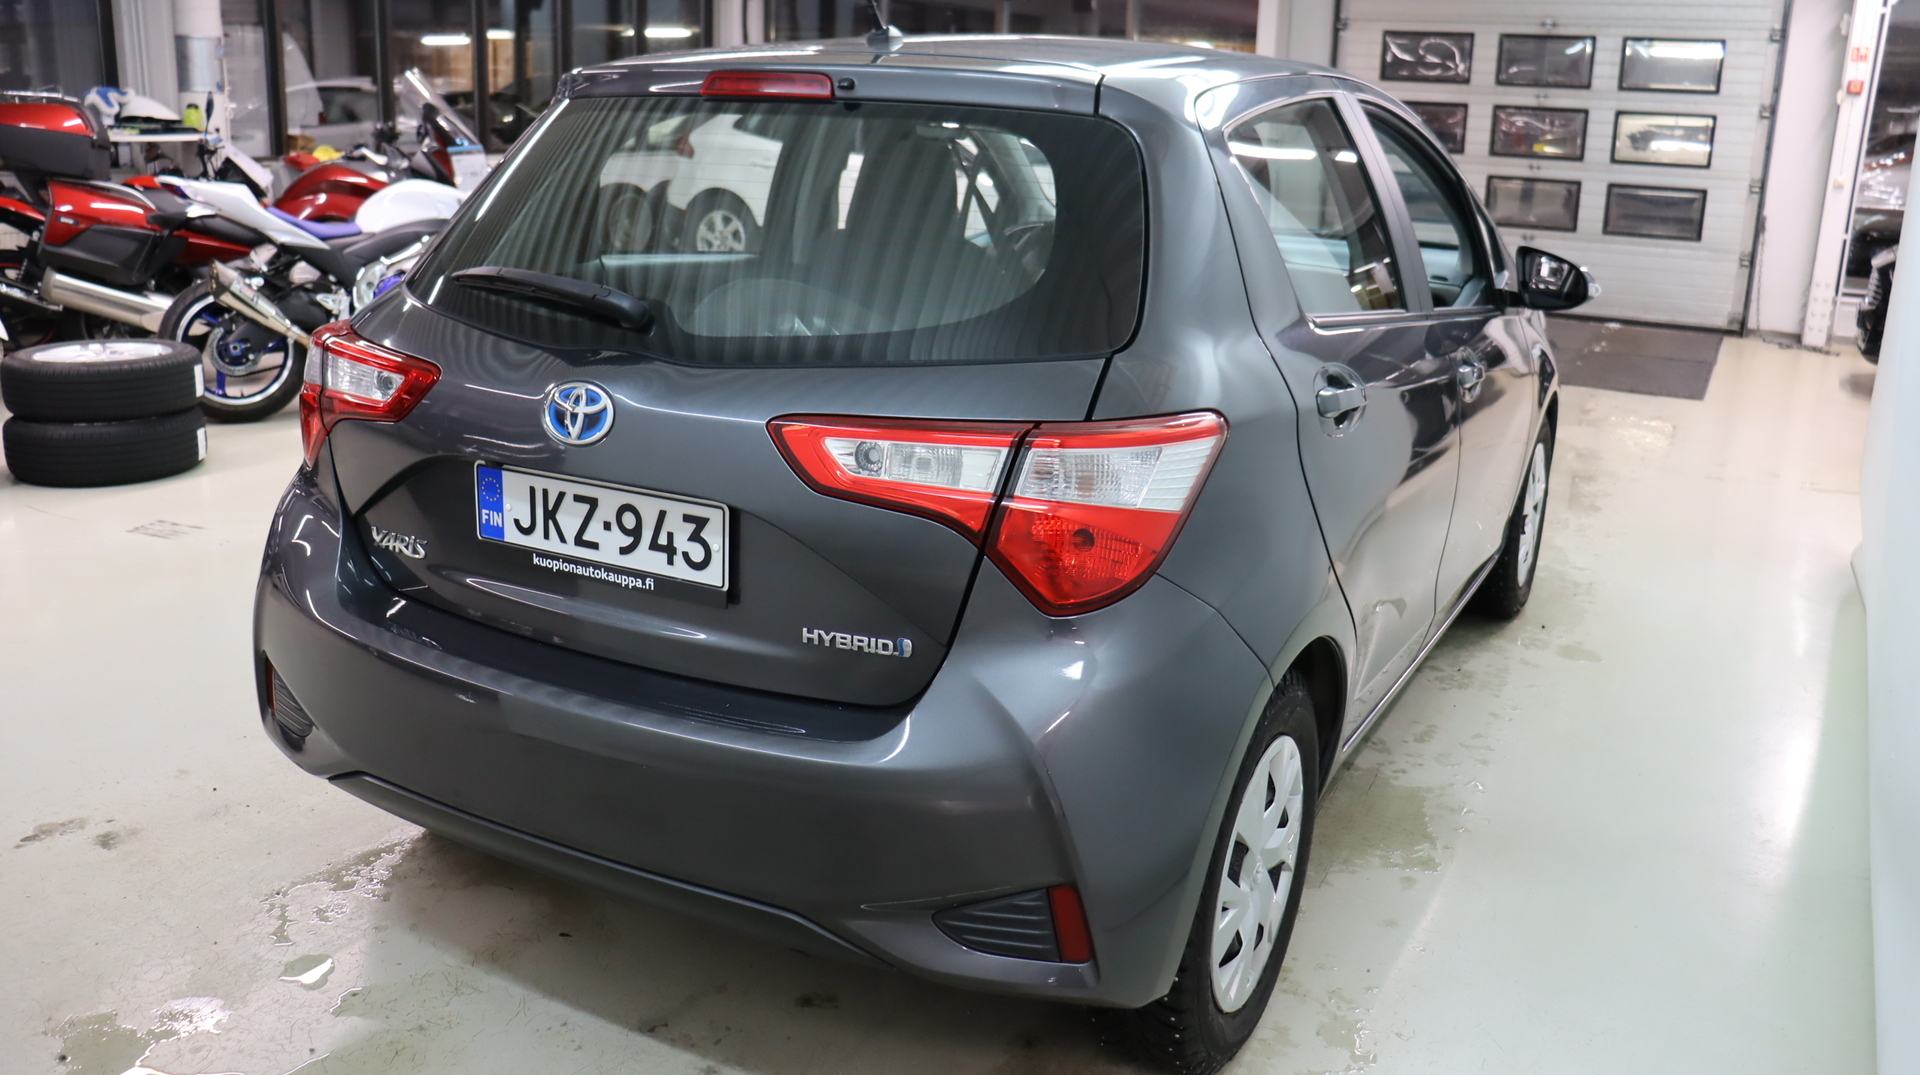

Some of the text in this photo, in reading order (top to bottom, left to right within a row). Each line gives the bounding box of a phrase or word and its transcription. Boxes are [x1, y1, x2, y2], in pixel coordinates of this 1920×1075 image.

[481, 508, 503, 528] FIN
[513, 485, 712, 571] JKZ-943
[533, 553, 655, 590] kuopionautokauppa.fi
[802, 627, 894, 656] HYBRID
